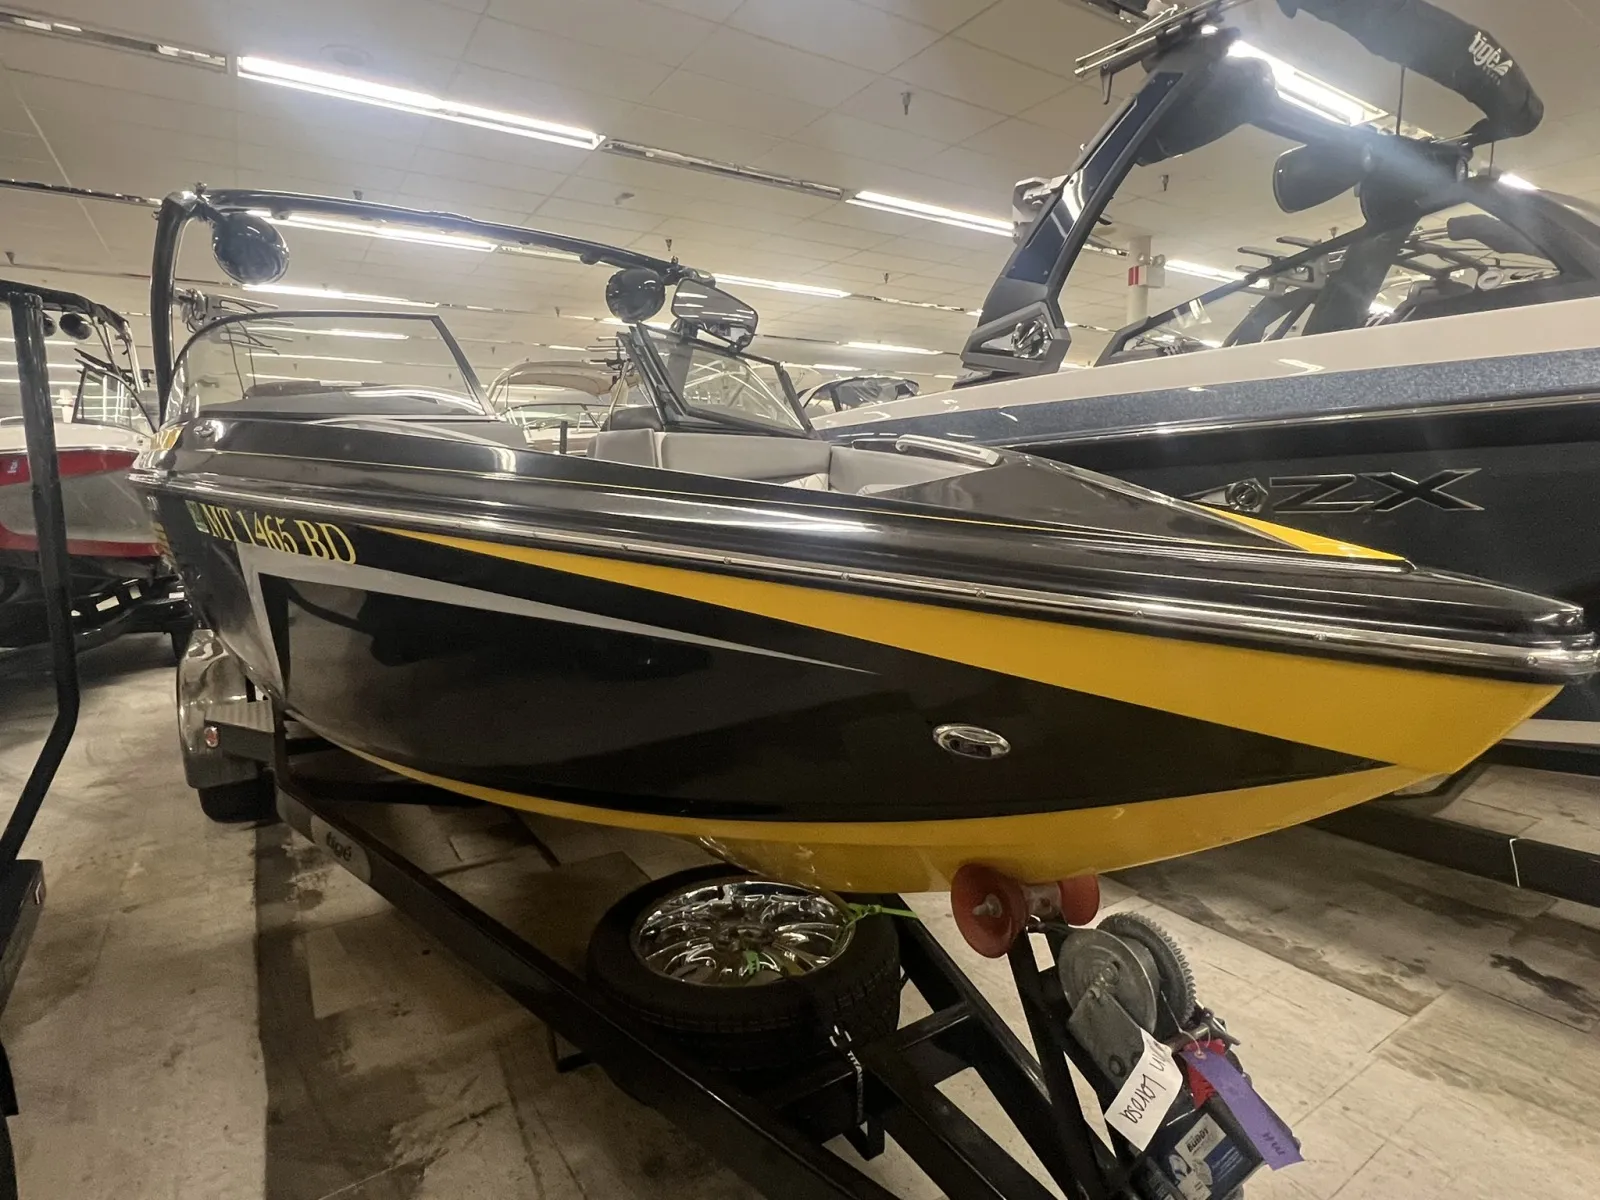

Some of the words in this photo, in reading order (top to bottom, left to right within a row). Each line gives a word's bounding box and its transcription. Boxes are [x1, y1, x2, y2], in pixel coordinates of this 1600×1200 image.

[1269, 467, 1486, 514] ZX
[199, 502, 240, 542] MT
[236, 510, 299, 554] 1465
[293, 519, 357, 565] BD
